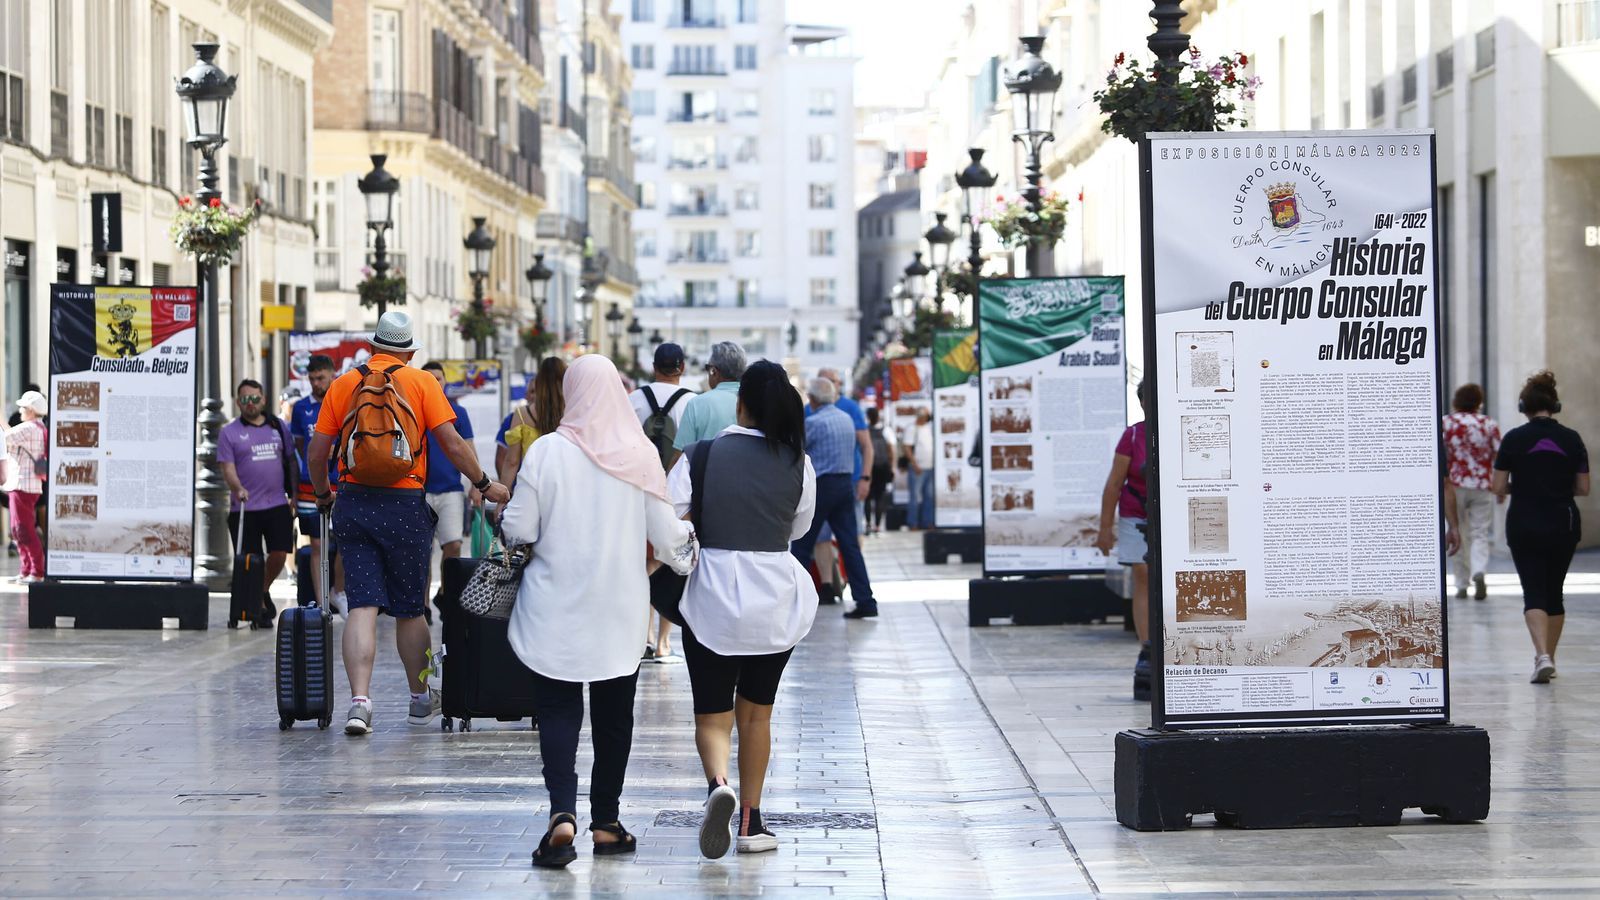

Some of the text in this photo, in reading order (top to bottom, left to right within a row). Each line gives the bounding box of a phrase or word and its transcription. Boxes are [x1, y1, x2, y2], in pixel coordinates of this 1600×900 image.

[1160, 143, 1420, 160] EXPOSICIÓN MÁLAGA 2022
[1233, 160, 1337, 226] CUERPO CONSULAR
[1374, 214, 1394, 229] 1641
[1401, 213, 1427, 229] 2022
[1255, 244, 1332, 276] EN MÁLAGA
[1330, 237, 1425, 276] Historia
[1205, 278, 1427, 325] del Cuerpo Consular
[1318, 320, 1427, 365] en Málaga
[92, 356, 144, 373] Consulado
[152, 358, 188, 376] Bélgica
